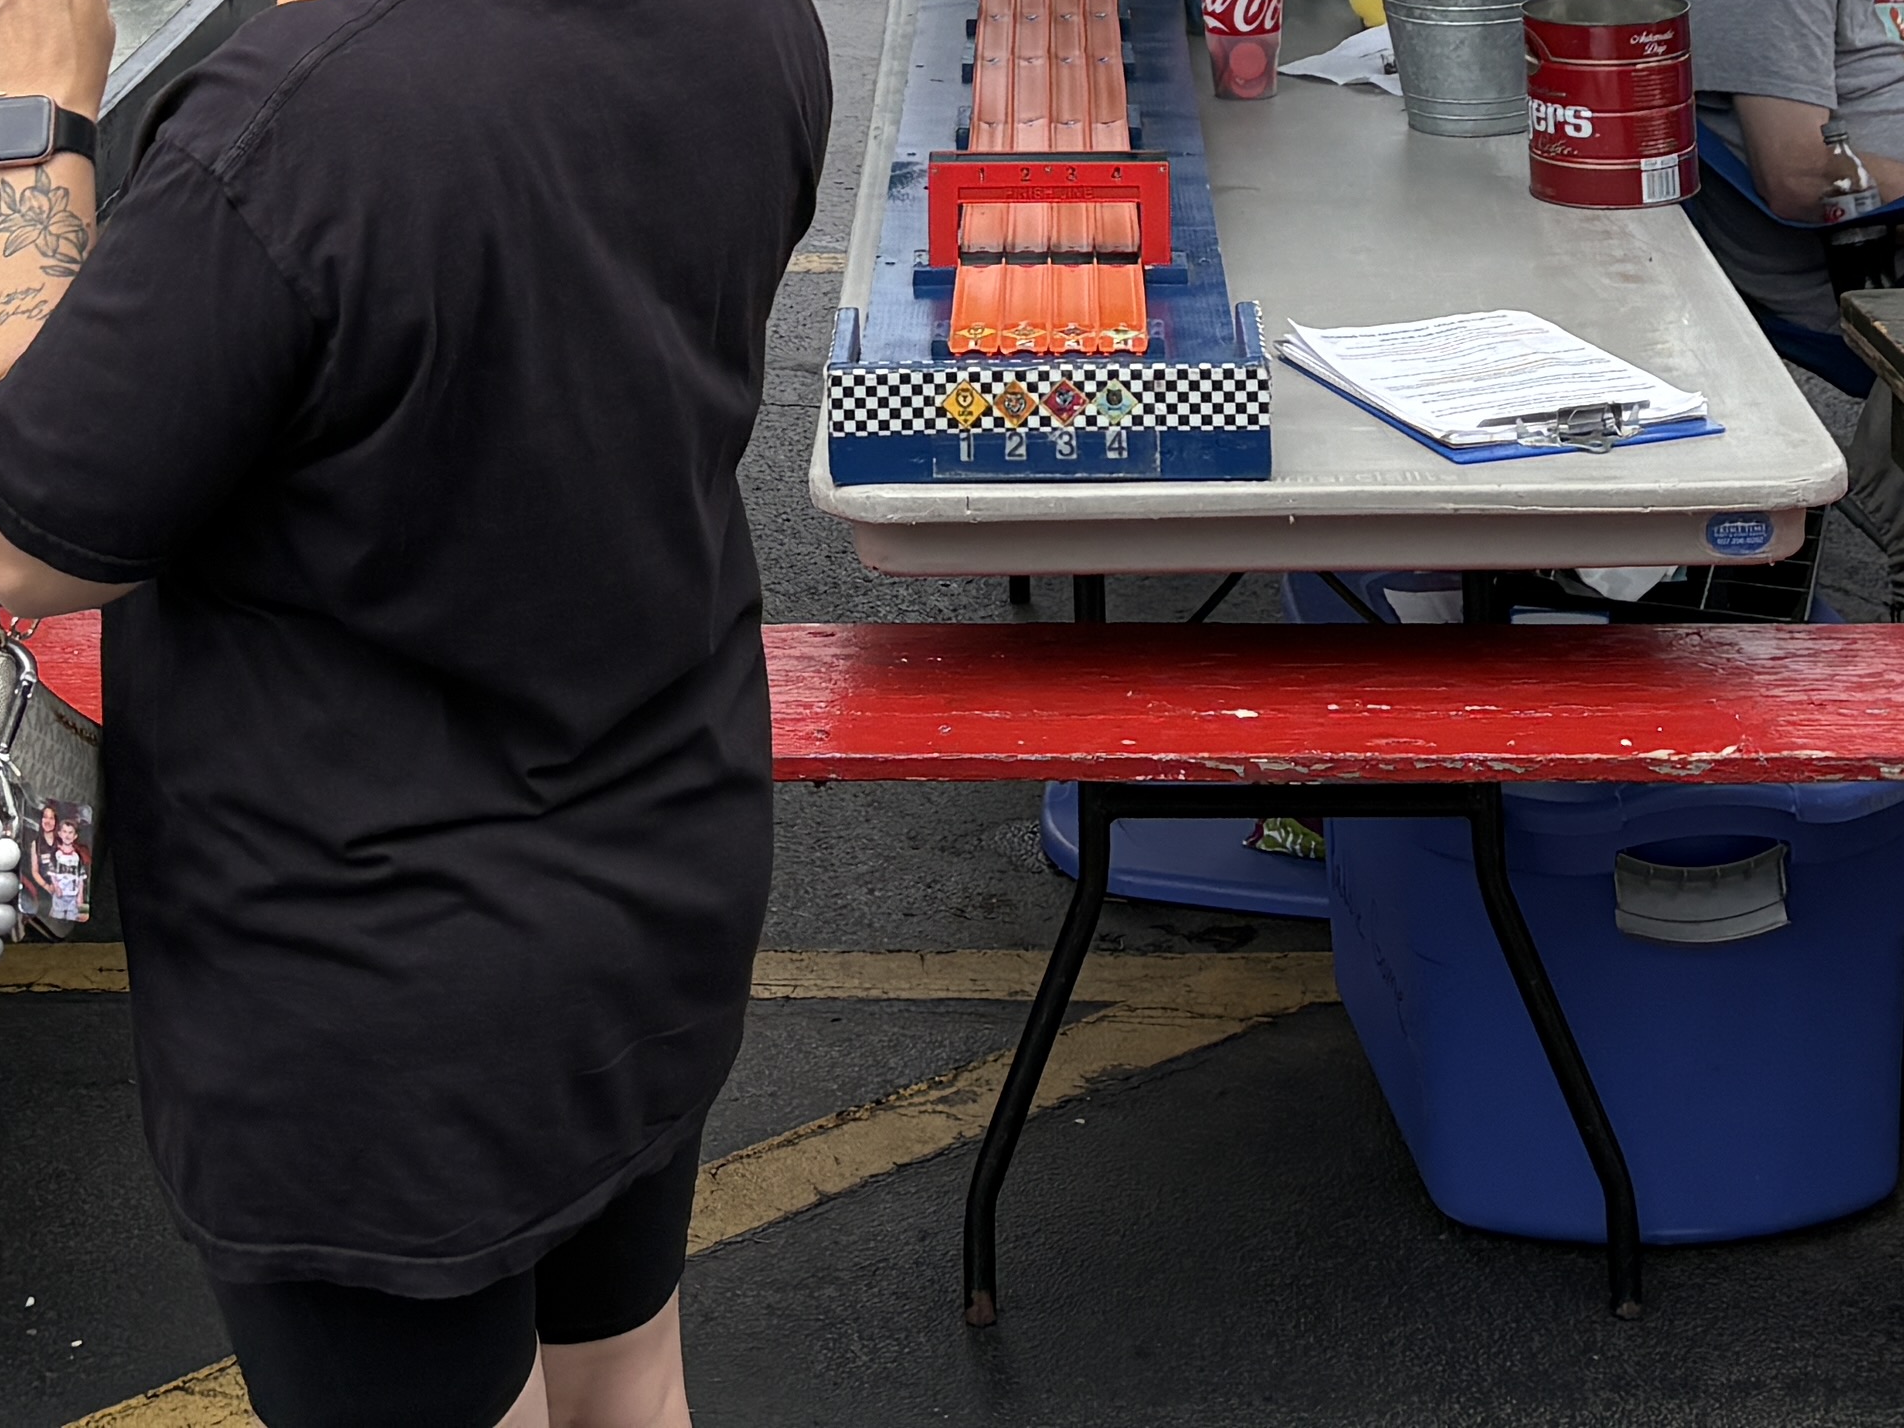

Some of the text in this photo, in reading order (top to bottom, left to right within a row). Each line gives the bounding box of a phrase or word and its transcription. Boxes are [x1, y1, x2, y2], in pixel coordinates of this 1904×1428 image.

[978, 167, 986, 182] 1
[1019, 167, 1033, 183] 2
[1065, 166, 1078, 182] 3
[1110, 166, 1123, 181] 4
[961, 432, 973, 462] 1
[1007, 431, 1025, 459] 2
[1057, 430, 1075, 458] 3
[1107, 430, 1126, 458] 4
